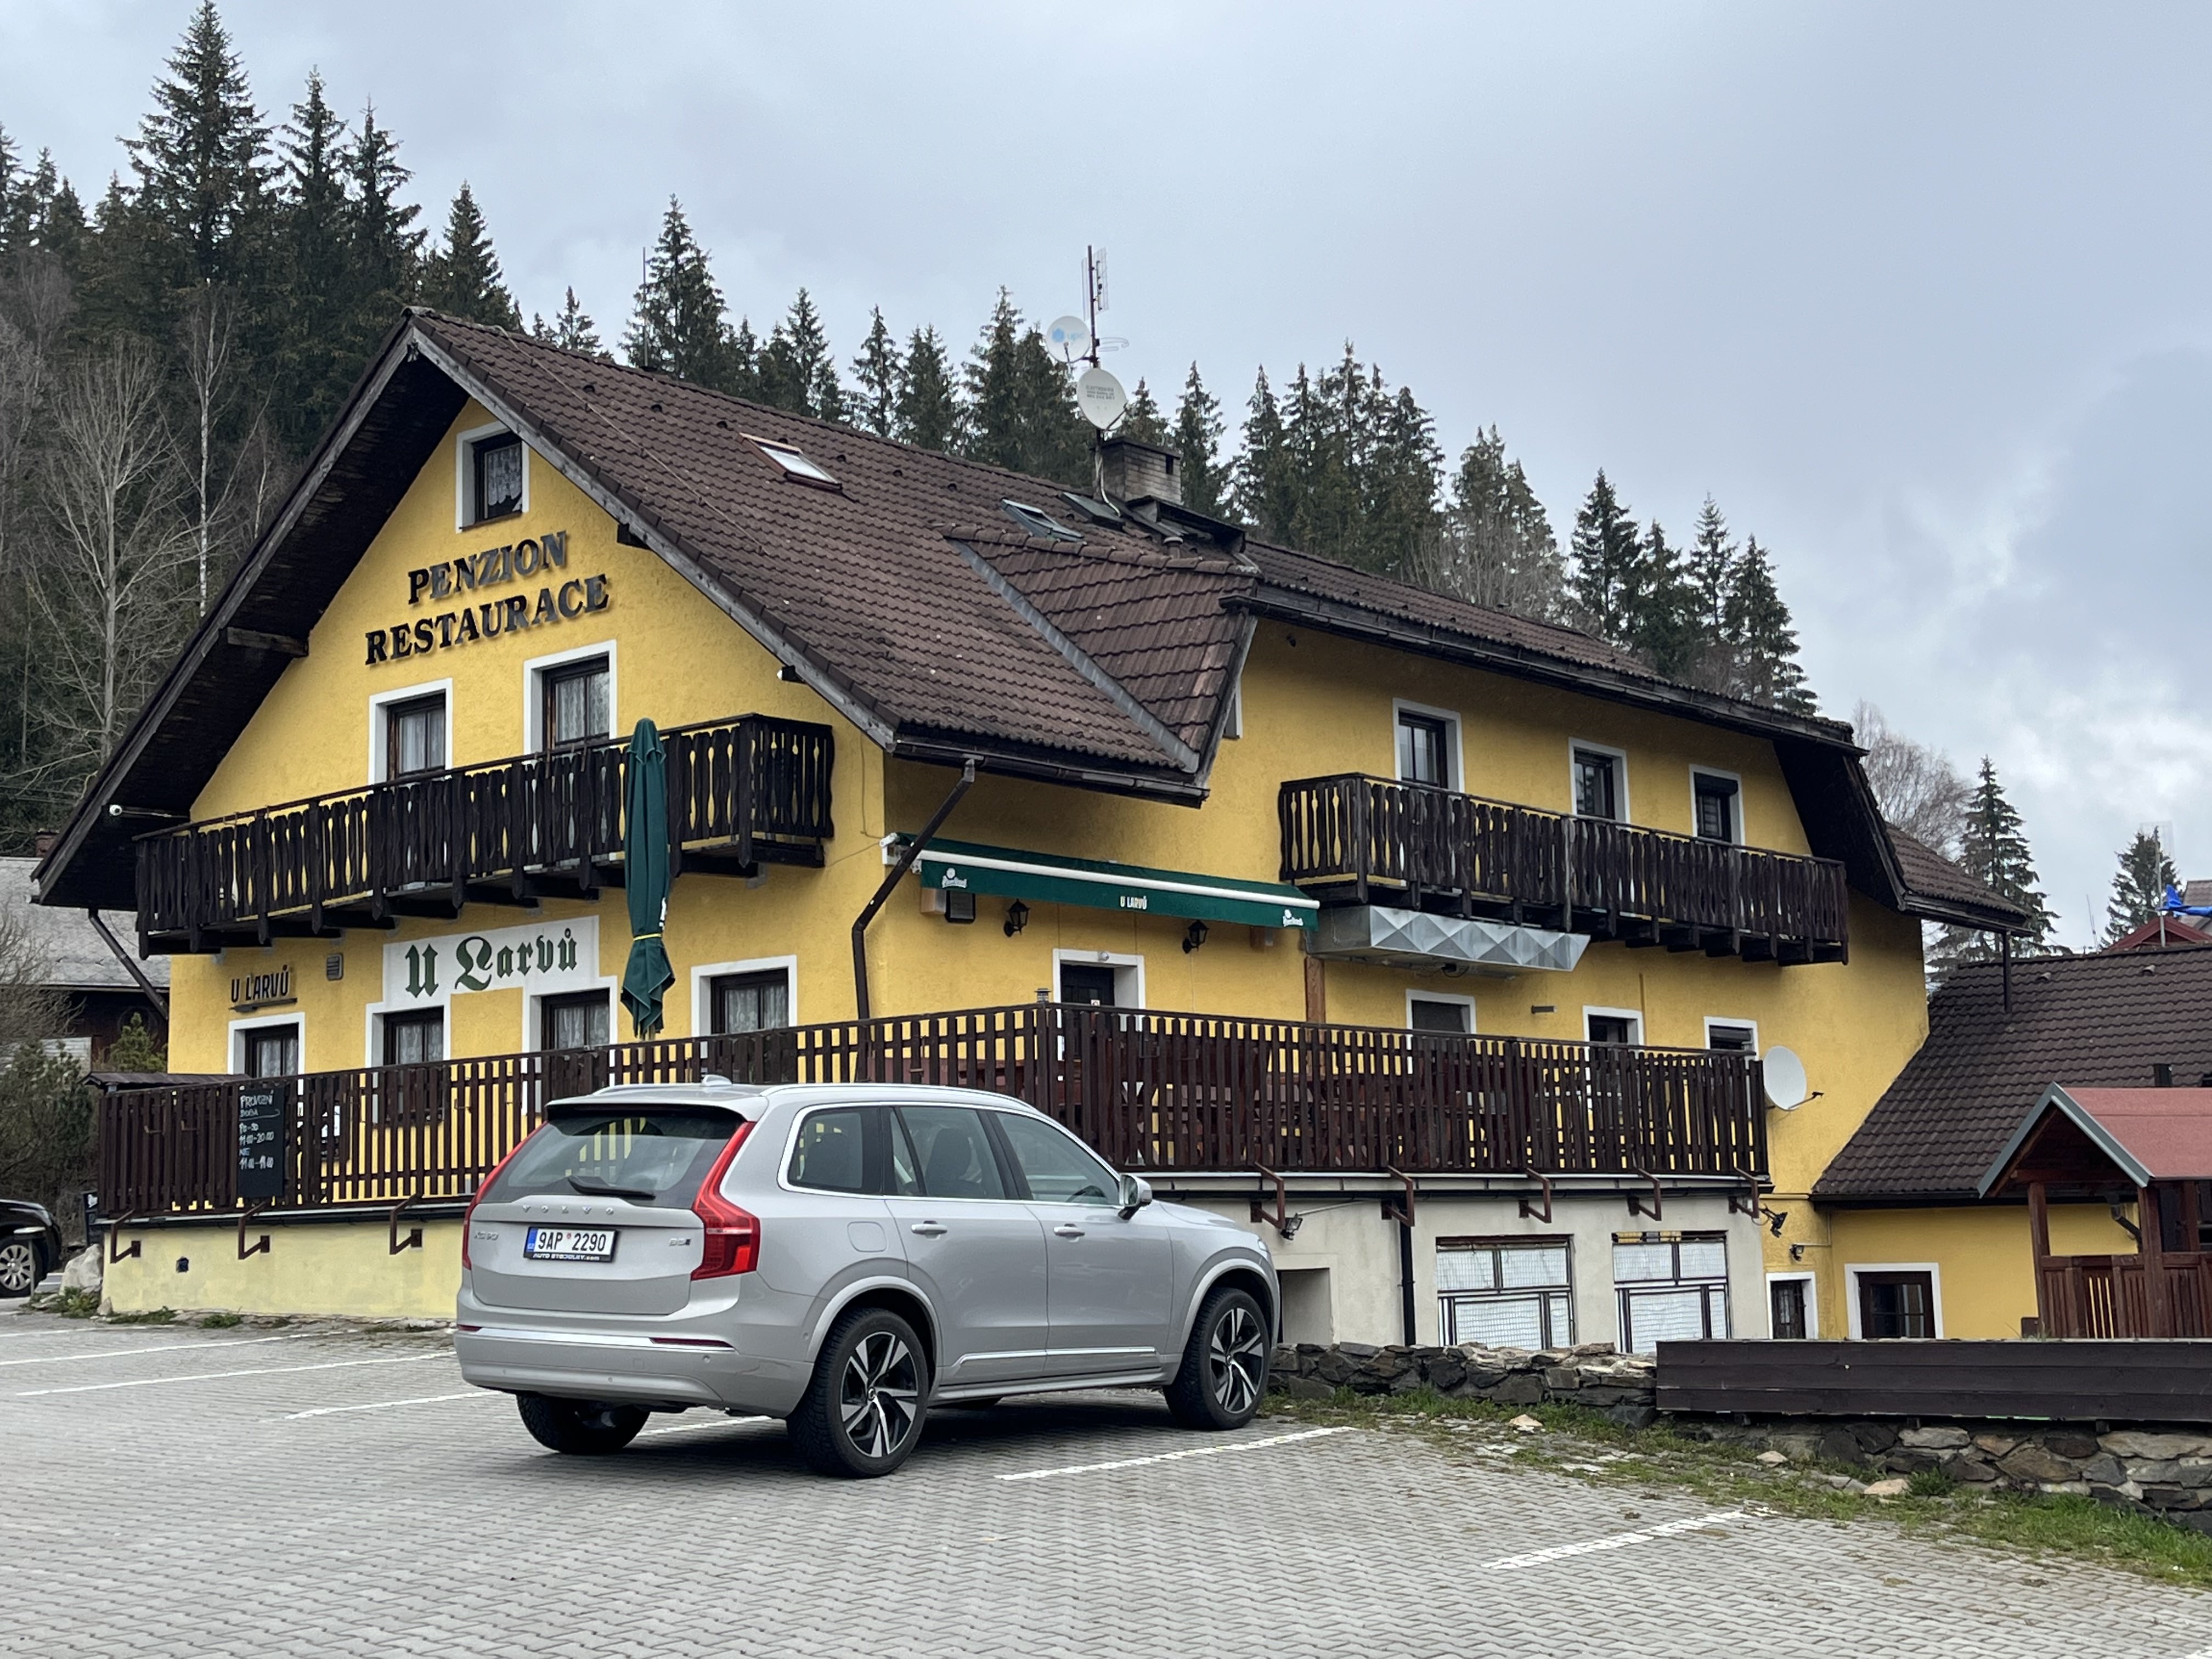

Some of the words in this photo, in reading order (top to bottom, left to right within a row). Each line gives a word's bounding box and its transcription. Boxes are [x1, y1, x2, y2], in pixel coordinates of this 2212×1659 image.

[408, 531, 567, 605] PENZION
[365, 573, 610, 665] RESTAURACE
[1120, 896, 1125, 907] U
[1127, 895, 1147, 910] LARVŮ
[405, 943, 439, 998] U
[454, 928, 577, 991] Larvů
[231, 978, 240, 1003] U
[246, 964, 289, 1001] LARVŮ
[522, 1205, 614, 1215] VOLVO
[538, 1232, 563, 1250] 9AP
[572, 1233, 606, 1251] 2290
